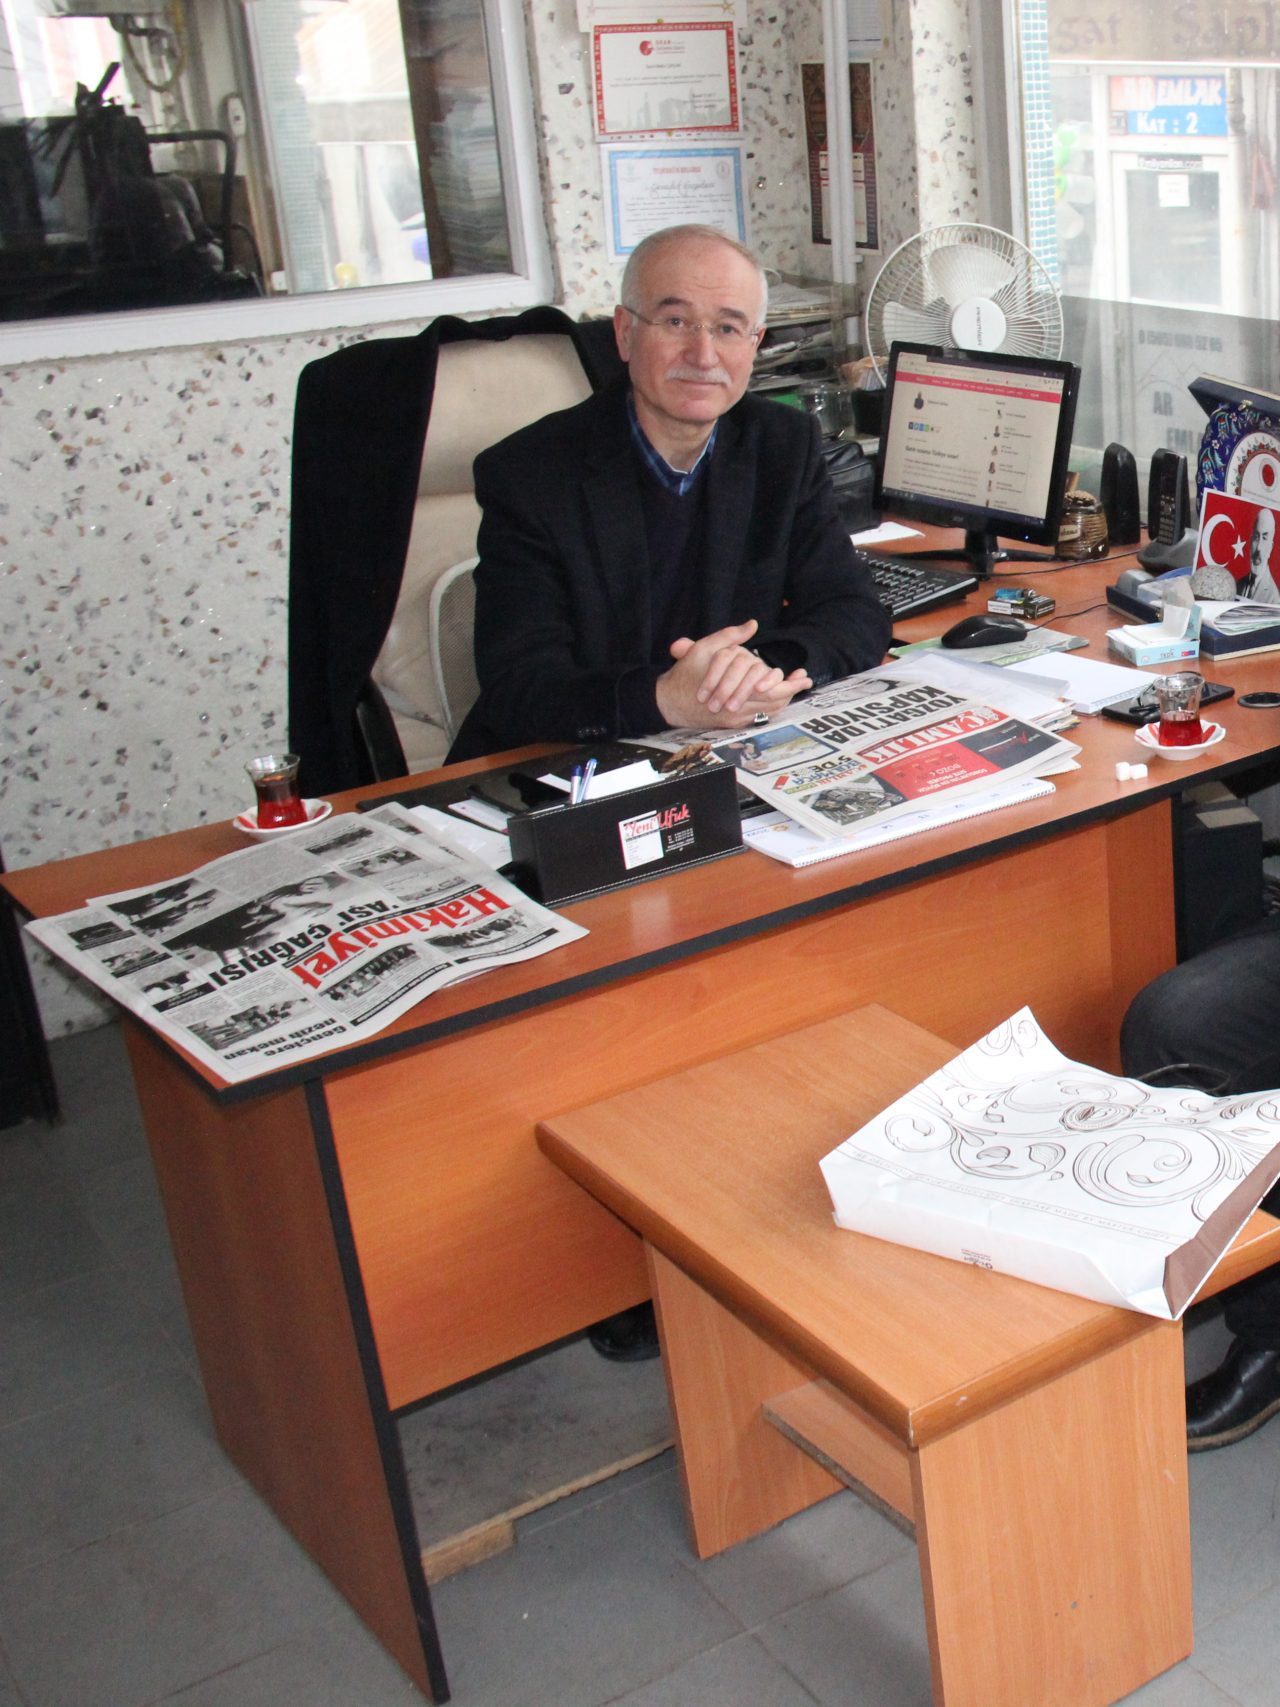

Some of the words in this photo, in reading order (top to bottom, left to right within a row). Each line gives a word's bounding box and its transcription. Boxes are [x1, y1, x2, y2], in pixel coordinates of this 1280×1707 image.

[1156, 79, 1223, 106] EMLAK
[1186, 111, 1199, 133] 2
[801, 685, 947, 735] KAPSIYOR
[823, 725, 866, 745] DA
[861, 711, 988, 765] ÇAMLIK
[655, 803, 690, 828] Ufuk
[208, 923, 332, 987] ÇAĞRISI
[223, 1036, 287, 1061] mekan
